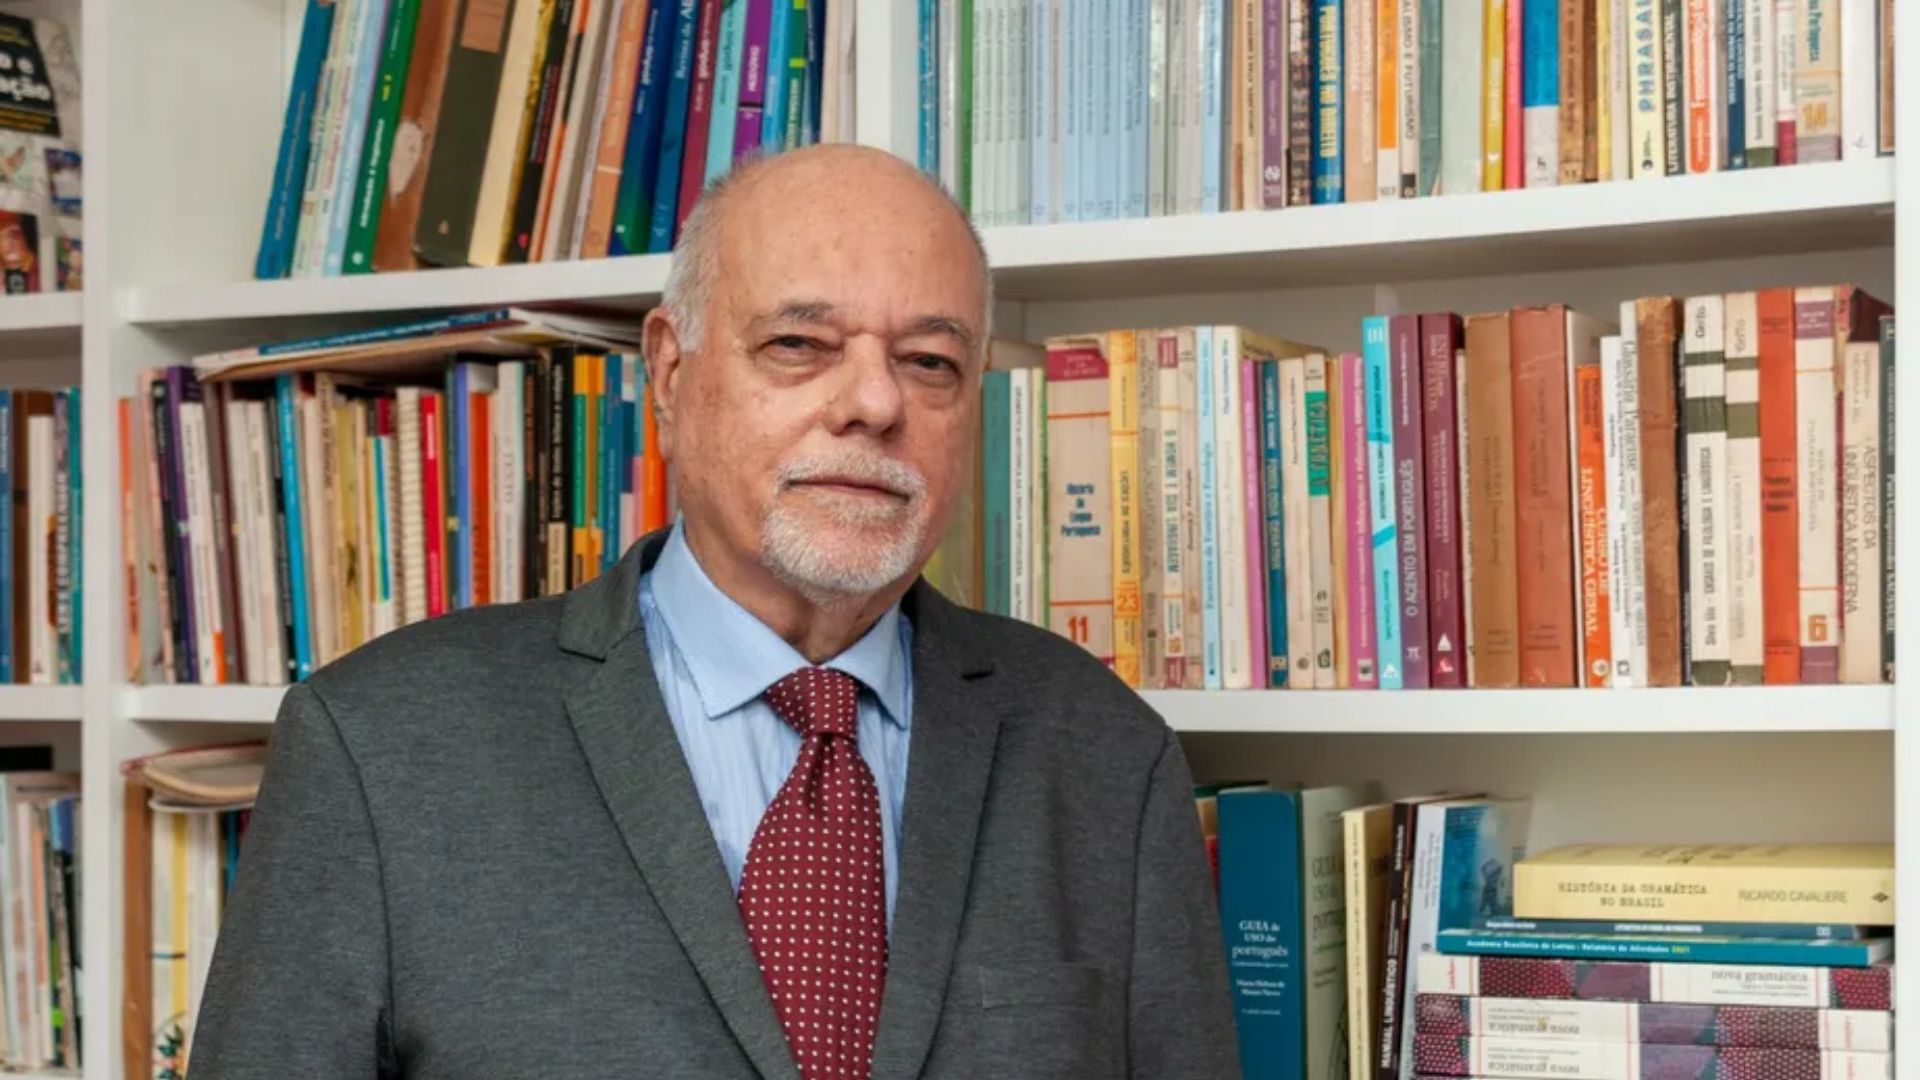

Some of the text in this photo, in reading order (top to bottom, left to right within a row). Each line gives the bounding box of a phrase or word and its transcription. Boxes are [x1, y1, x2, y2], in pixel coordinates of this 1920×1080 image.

[1404, 66, 1417, 140] FUTURISMO
[1862, 444, 1878, 550] ASPECTOS DA
[1399, 459, 1418, 617] O ACENTO EM PORTUGUÊS
[1844, 537, 1859, 614] MODERNA
[1584, 578, 1598, 637] GERAL
[1067, 616, 1088, 644] 11
[1808, 615, 1828, 641] 6
[1558, 882, 1707, 896] HISTÓRIA DA GRAMÁTICA
[1600, 897, 1664, 908] NO BRASIL
[1739, 890, 1847, 903] RICARDO CAVALIERE
[1239, 920, 1268, 931] GUIA
[1244, 933, 1264, 942] USO
[1231, 946, 1289, 960] português
[1467, 940, 1501, 950] Academia
[1504, 940, 1538, 950] Brasileira
[1541, 942, 1550, 951] de
[1552, 942, 1576, 952] Letras
[1582, 942, 1615, 952] Relatório
[1618, 944, 1627, 953] de
[1711, 970, 1808, 984] nova gramática
[1381, 958, 1398, 1024] LINGUÍSTICO
[1550, 1025, 1580, 1035] nova
[1380, 1026, 1394, 1069] MANUAL
[1487, 1062, 1580, 1074] nova gramática
